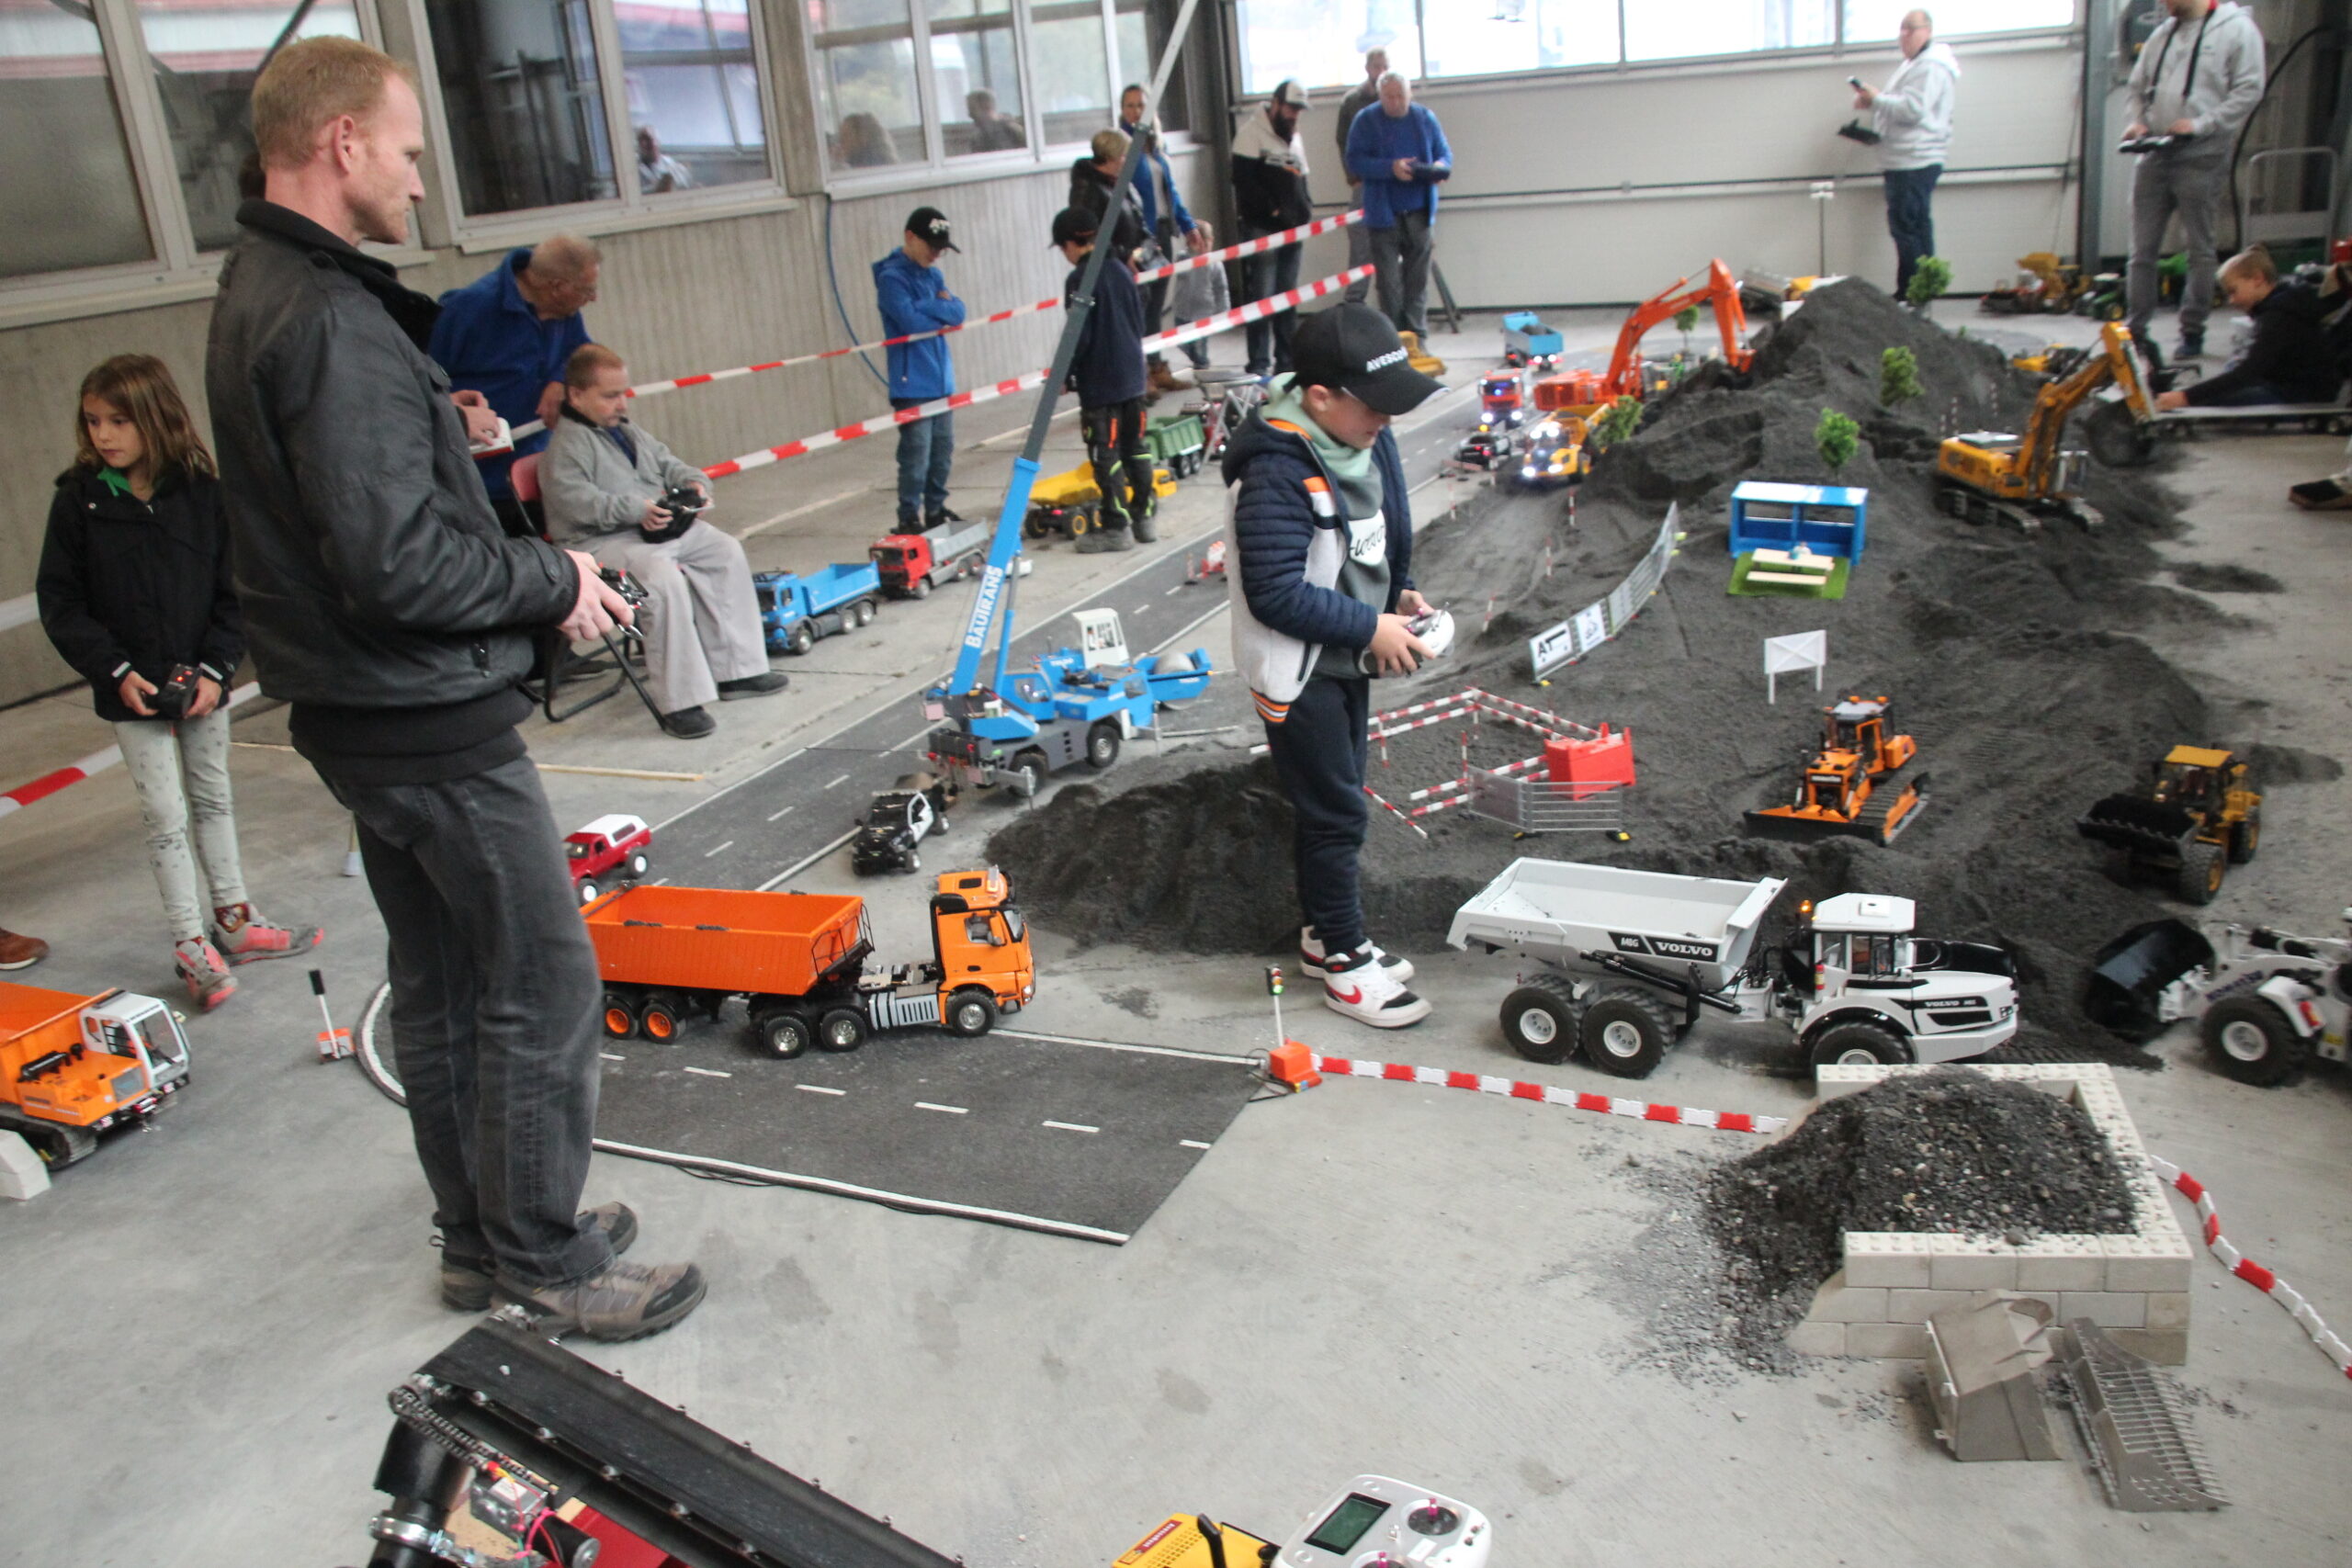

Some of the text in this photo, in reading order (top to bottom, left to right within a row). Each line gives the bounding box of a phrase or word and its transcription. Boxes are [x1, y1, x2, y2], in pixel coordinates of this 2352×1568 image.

[965, 565, 1003, 648] BAUTRANS
[1656, 941, 1713, 957] VOLVO
[1925, 999, 1961, 1008] VOLVO
